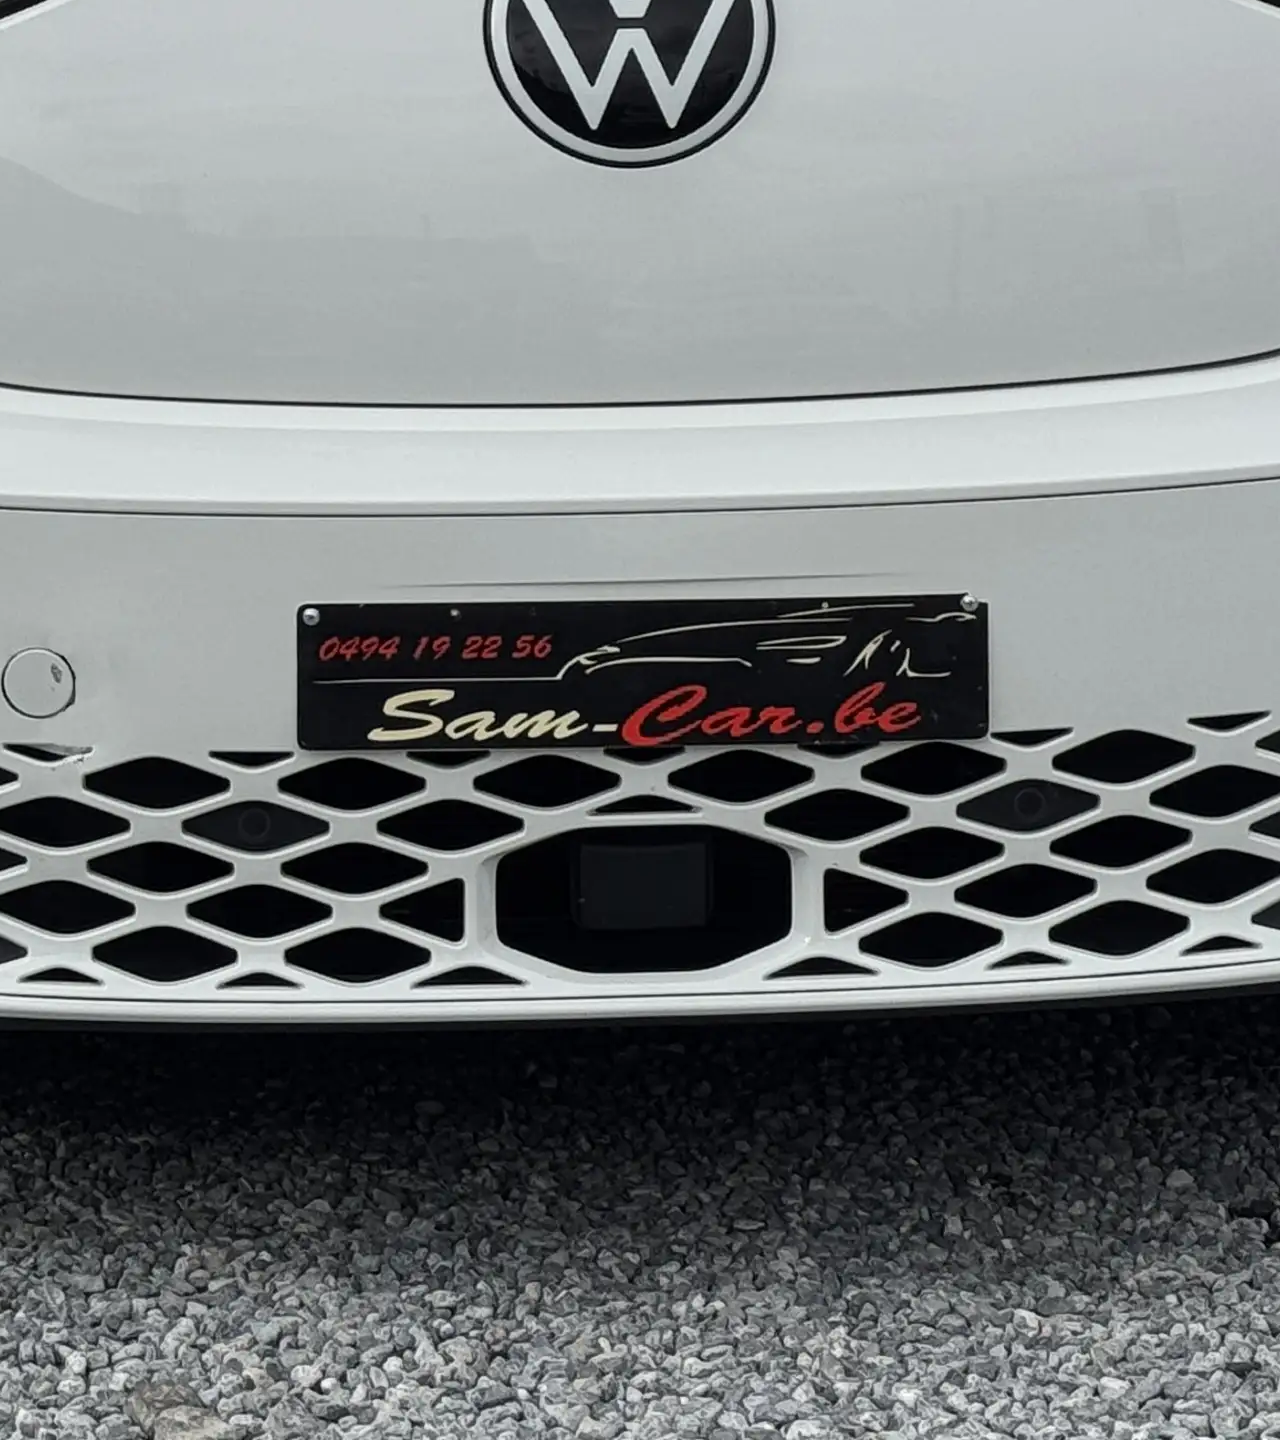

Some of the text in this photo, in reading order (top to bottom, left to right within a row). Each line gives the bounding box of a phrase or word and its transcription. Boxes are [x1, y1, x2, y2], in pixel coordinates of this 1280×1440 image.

[319, 633, 552, 661] 0494 19 22 56
[367, 681, 921, 747] Sam-Car.be
